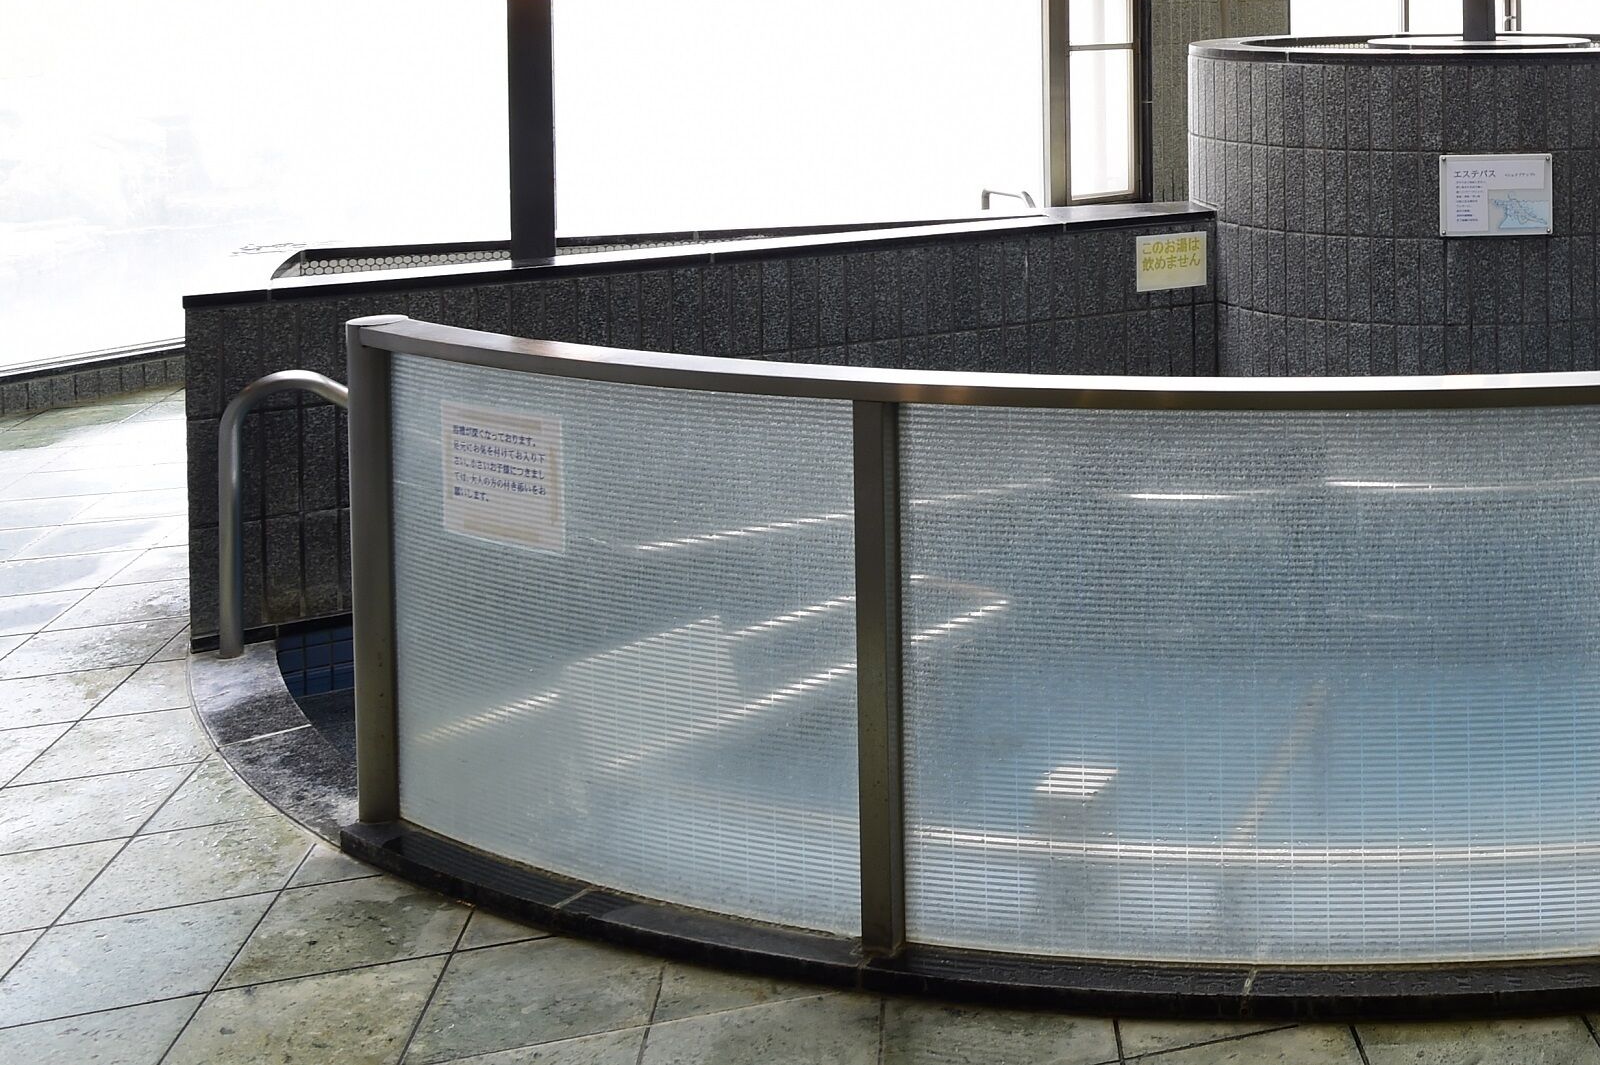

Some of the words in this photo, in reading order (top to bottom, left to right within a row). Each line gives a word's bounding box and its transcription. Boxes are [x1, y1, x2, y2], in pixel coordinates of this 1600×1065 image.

[1454, 169, 1497, 179] エステバス
[1142, 237, 1200, 255] このお湯は
[1142, 253, 1201, 272] 飲めません
